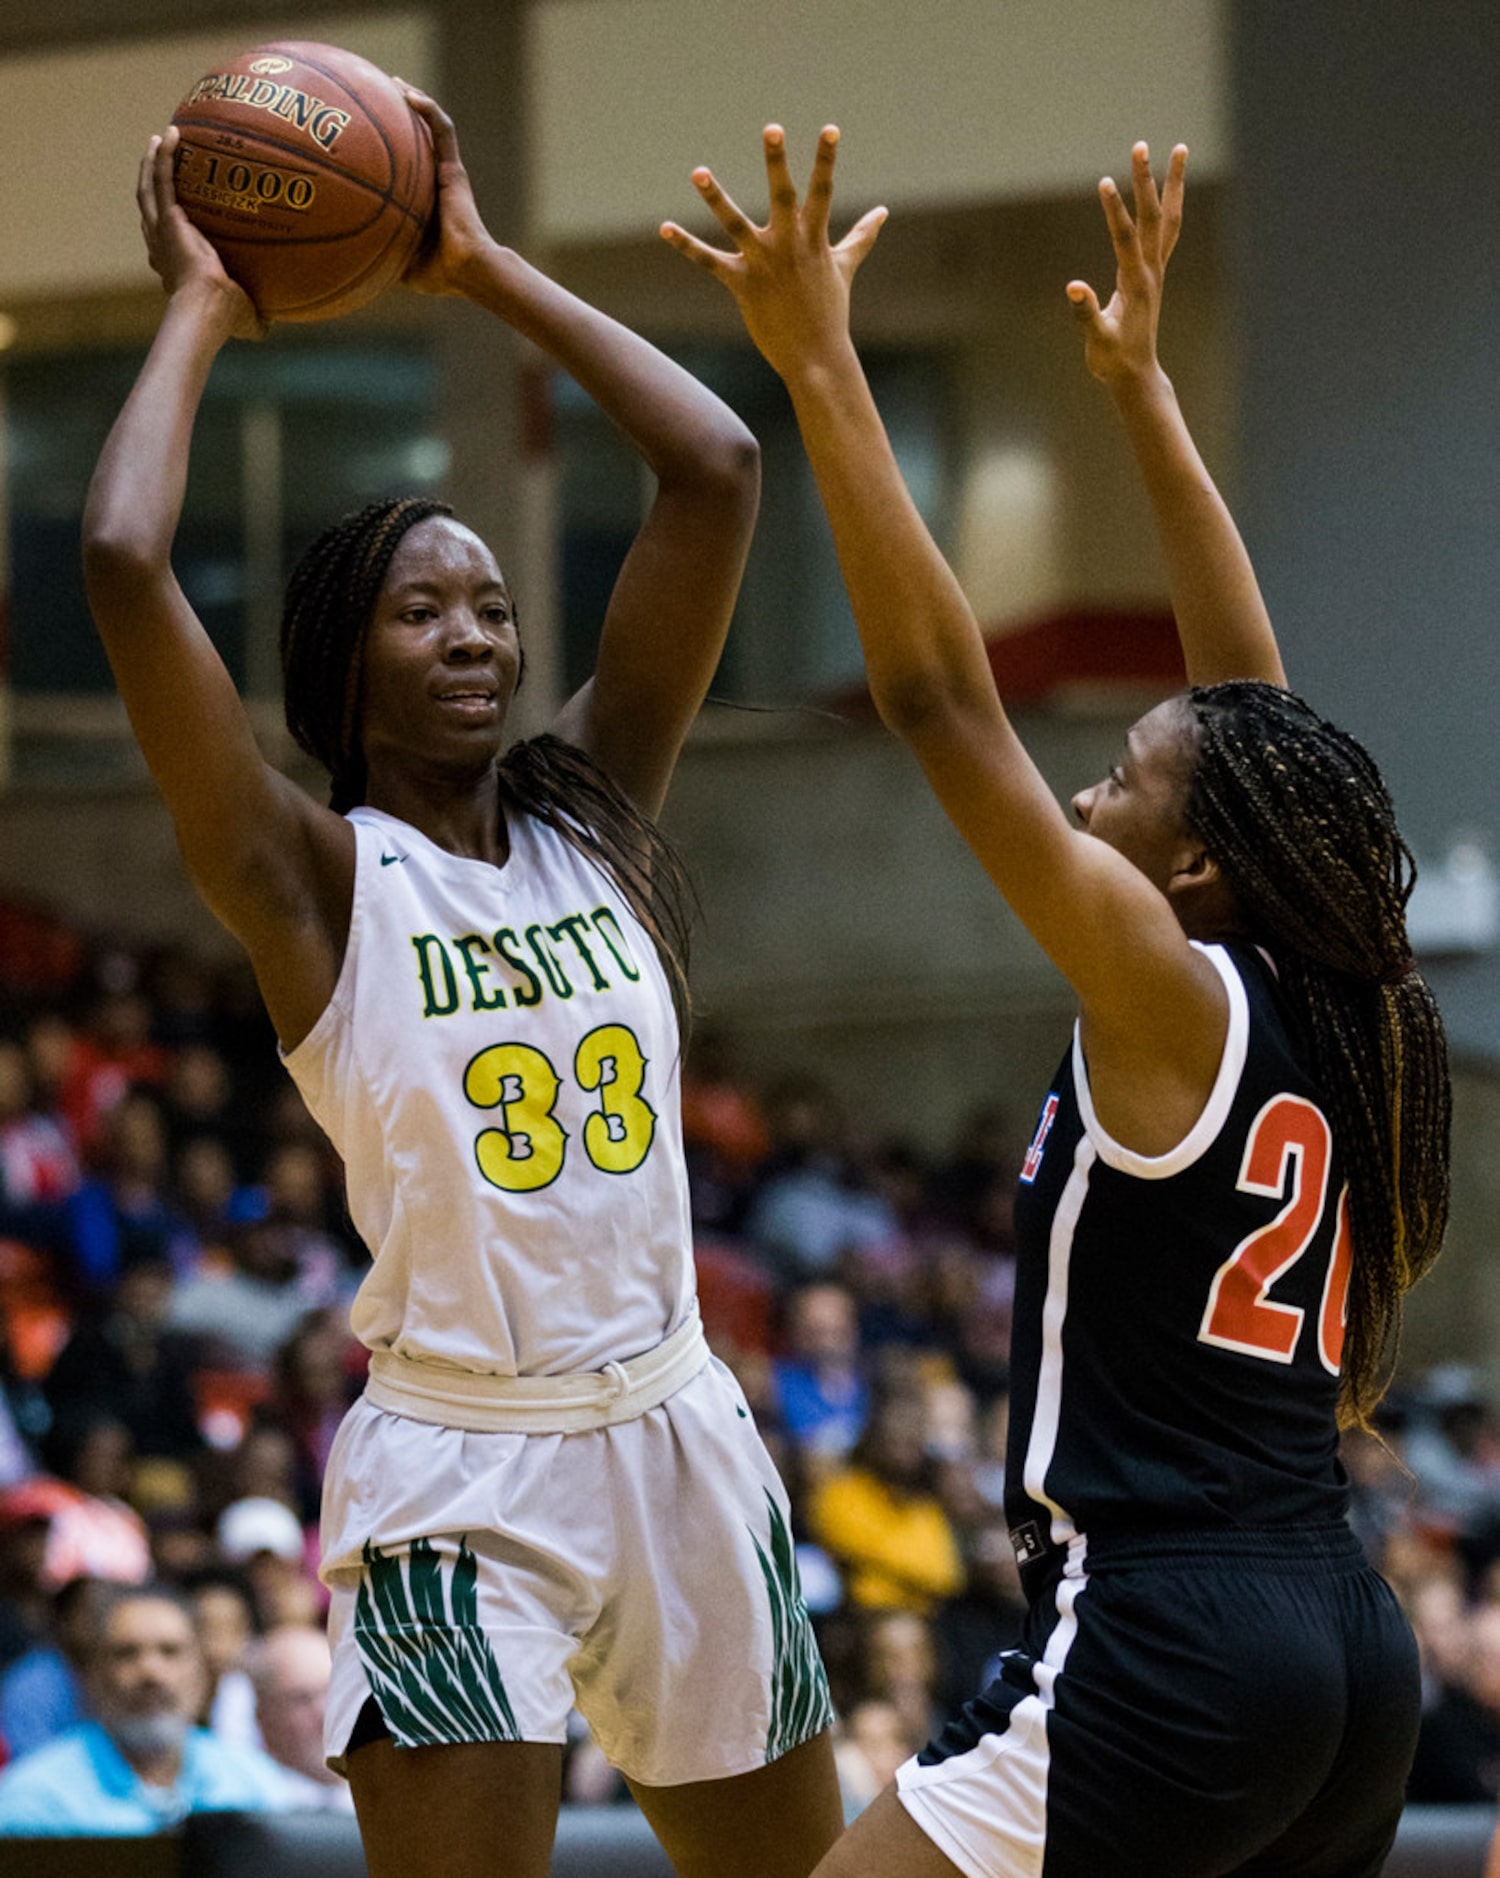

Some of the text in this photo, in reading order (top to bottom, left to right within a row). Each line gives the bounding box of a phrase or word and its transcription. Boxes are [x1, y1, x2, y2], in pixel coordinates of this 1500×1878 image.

[188, 73, 352, 151] PALDING
[412, 905, 641, 1019] DESOTO
[463, 1022, 658, 1194] 33
